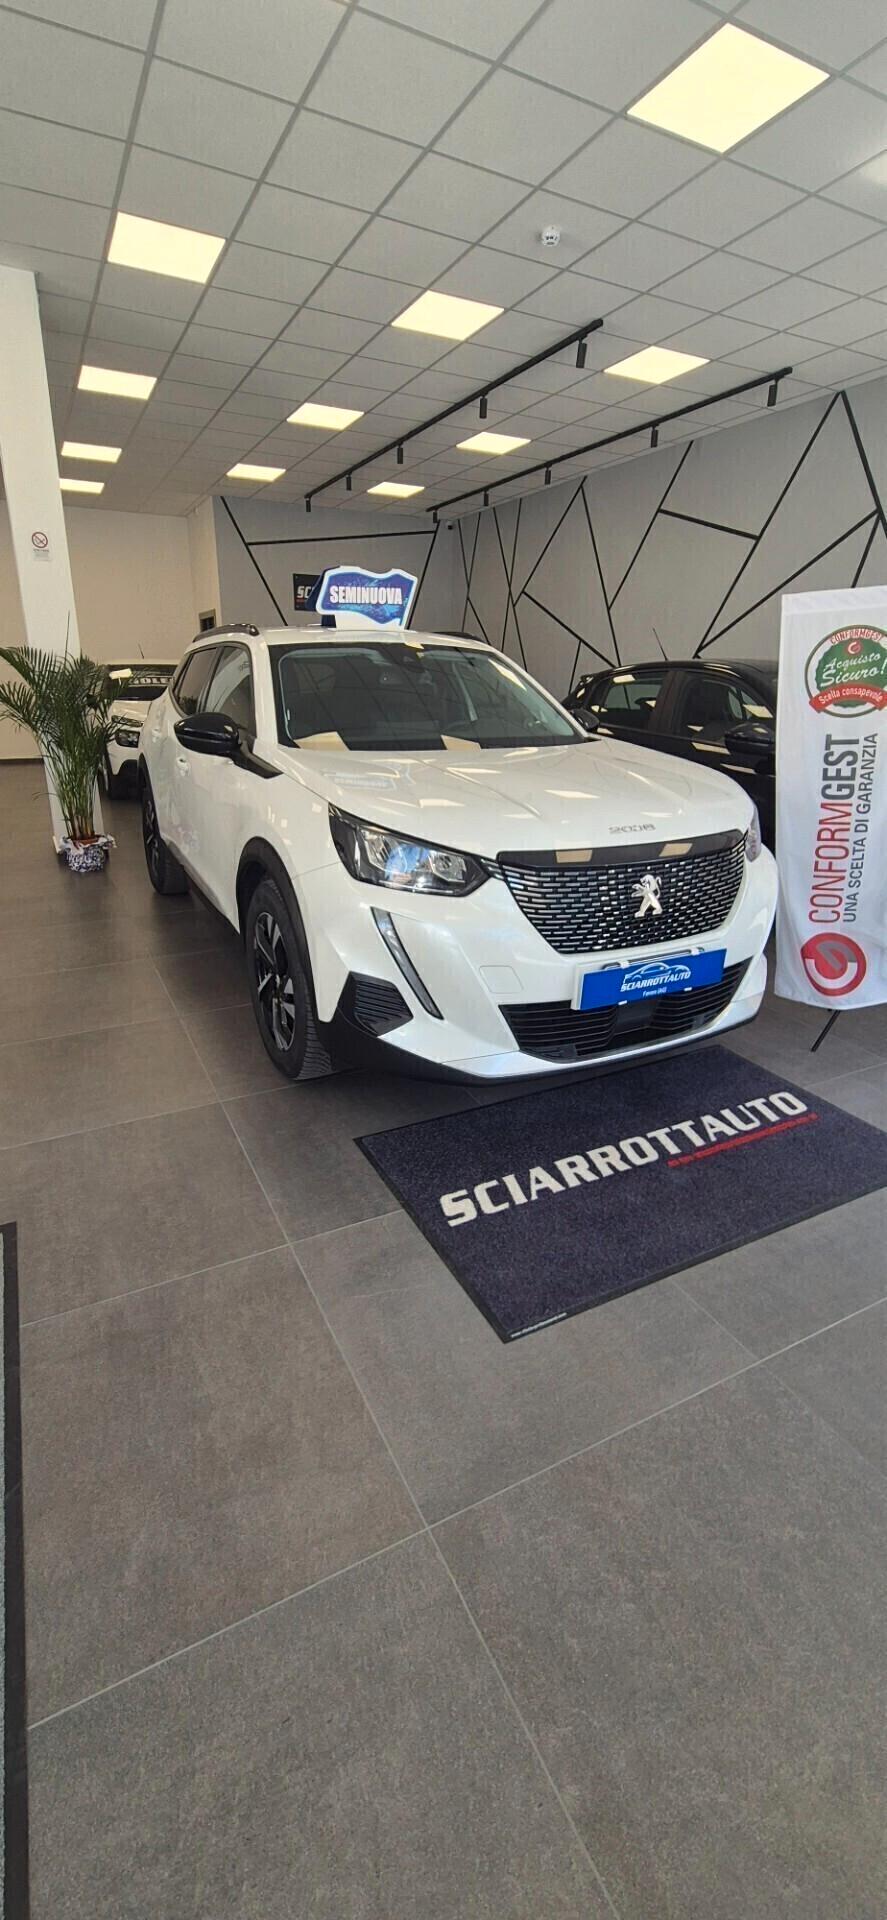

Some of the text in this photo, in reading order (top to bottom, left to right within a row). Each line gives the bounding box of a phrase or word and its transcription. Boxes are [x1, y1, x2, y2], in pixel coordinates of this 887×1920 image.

[329, 585, 403, 604] SEMINUOVA
[820, 658, 887, 687] Sicuro!
[822, 652, 881, 672] Acquisto
[841, 687, 884, 702] consapevole
[808, 733, 860, 924] CONFORMGEST
[843, 733, 878, 922] UNA SCELTA DI GARANZIA
[620, 970, 691, 992] SCIARROTTAUTO
[439, 1091, 808, 1228] SCIARROTTAUTO
